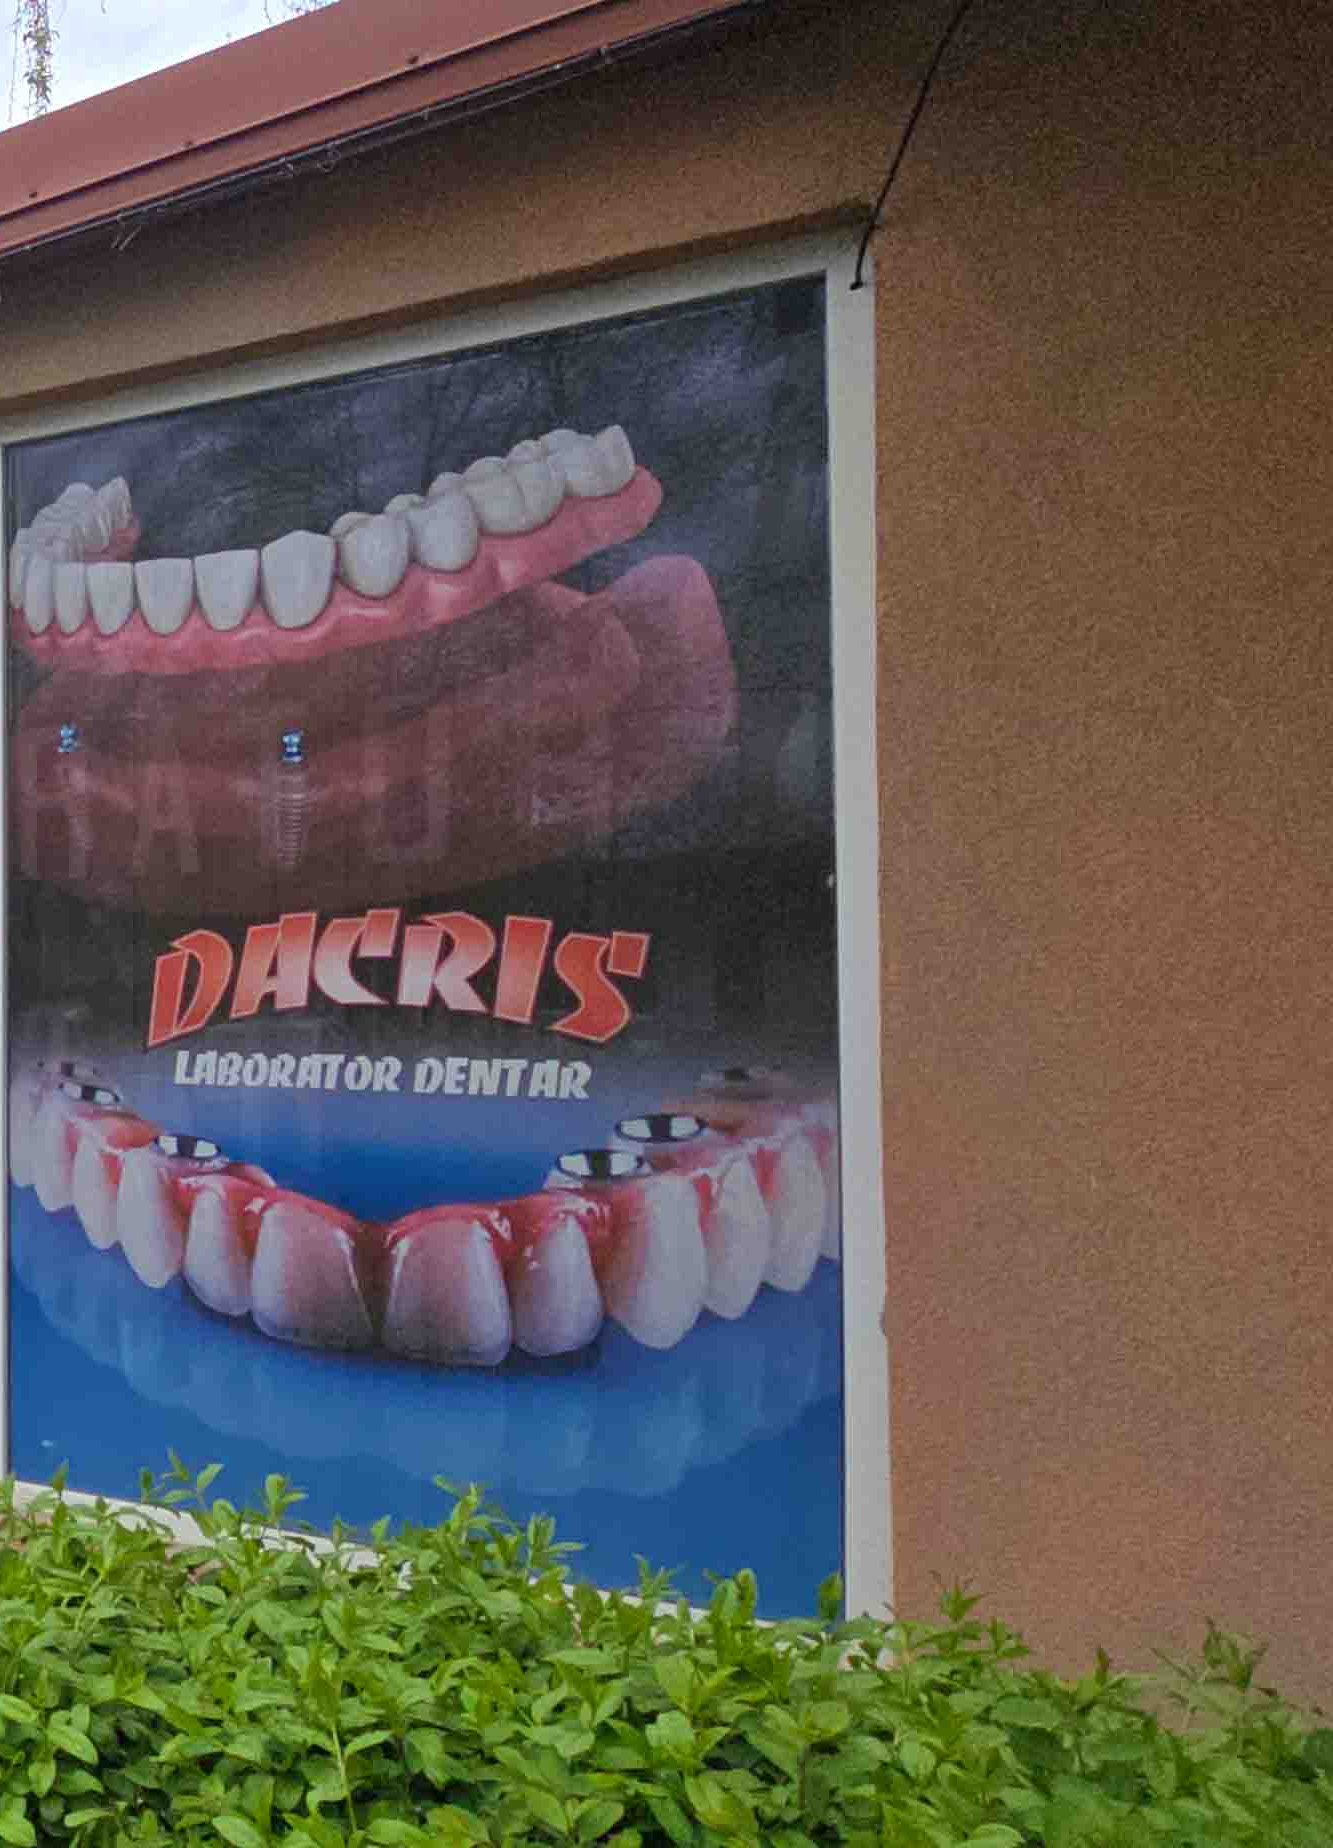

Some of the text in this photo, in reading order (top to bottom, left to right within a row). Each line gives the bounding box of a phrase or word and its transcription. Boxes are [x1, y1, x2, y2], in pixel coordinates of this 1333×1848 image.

[147, 907, 652, 1047] DACRIS
[173, 1049, 593, 1101] LABORATOR DENTAR
